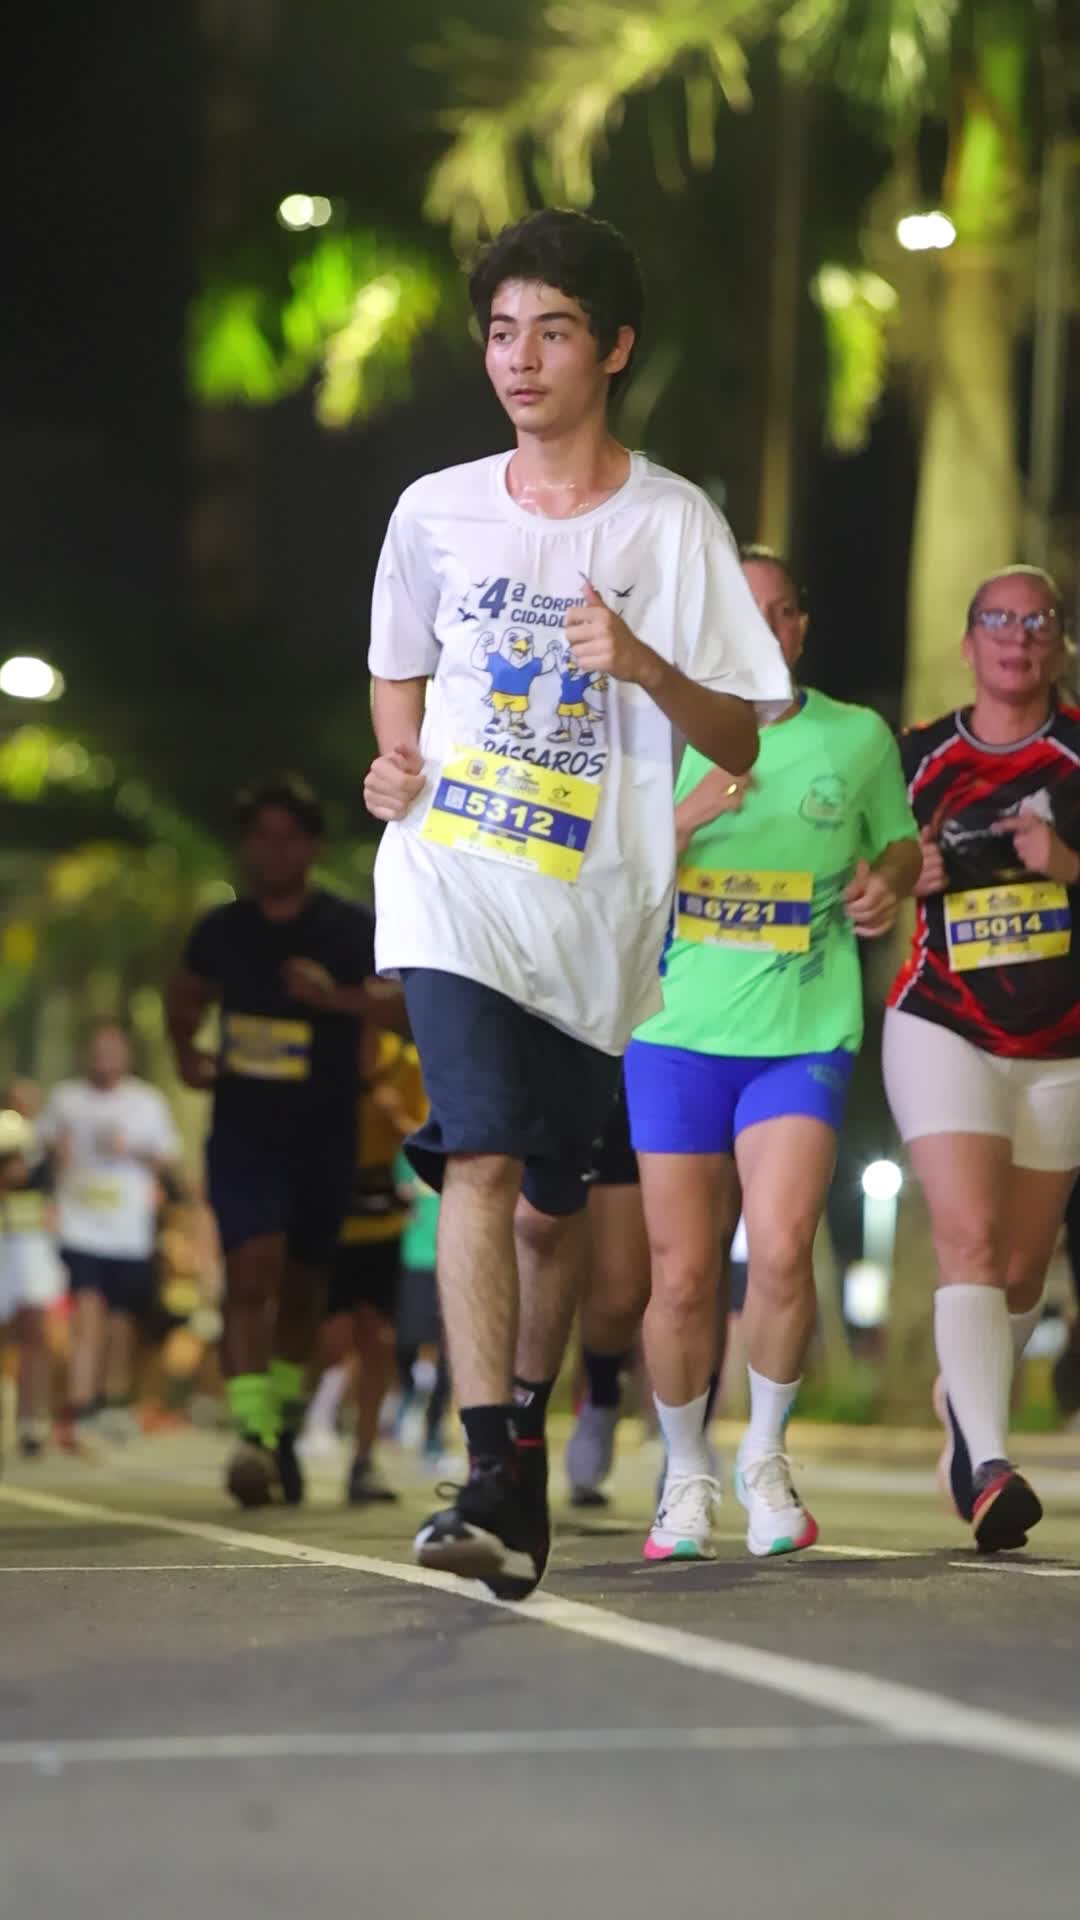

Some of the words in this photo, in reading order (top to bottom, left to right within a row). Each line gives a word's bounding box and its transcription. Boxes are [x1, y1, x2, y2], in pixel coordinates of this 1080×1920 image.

[465, 791, 554, 836] 5312
[704, 900, 776, 923] 6721
[974, 912, 1043, 940] 5014
